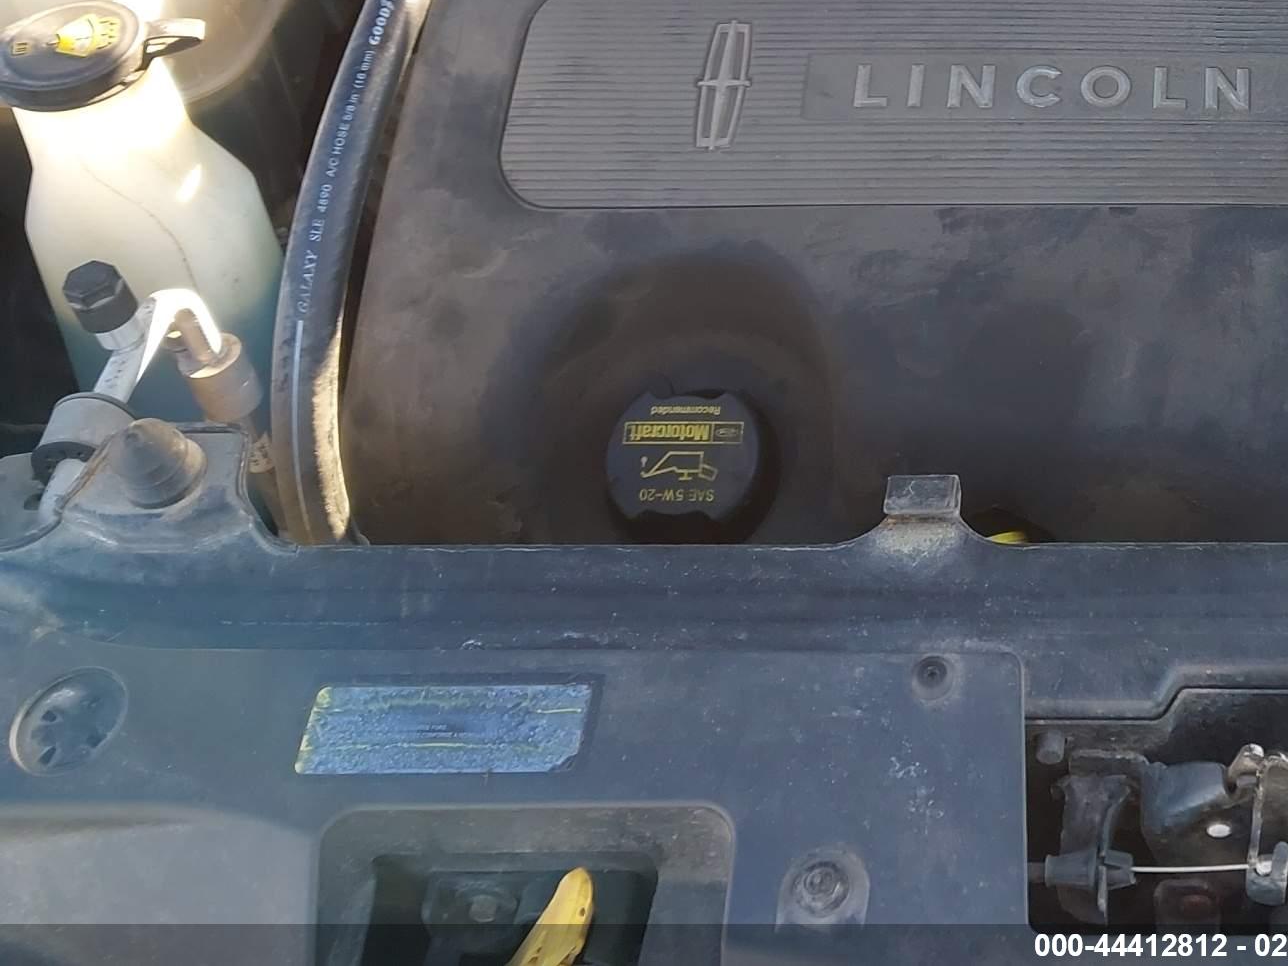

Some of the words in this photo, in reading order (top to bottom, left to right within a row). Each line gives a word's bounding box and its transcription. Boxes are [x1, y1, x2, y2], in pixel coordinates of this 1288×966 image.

[852, 62, 1253, 113] LINCOLN
[331, 122, 351, 155] HOSE
[325, 156, 341, 178] A/C
[316, 183, 333, 213] 4890
[308, 219, 325, 242] SLE
[297, 249, 318, 314] GALAXY
[650, 405, 721, 416] Recommended
[630, 424, 710, 441] Motorcraft
[639, 488, 684, 502] 5W-20
[688, 489, 715, 502] SAE
